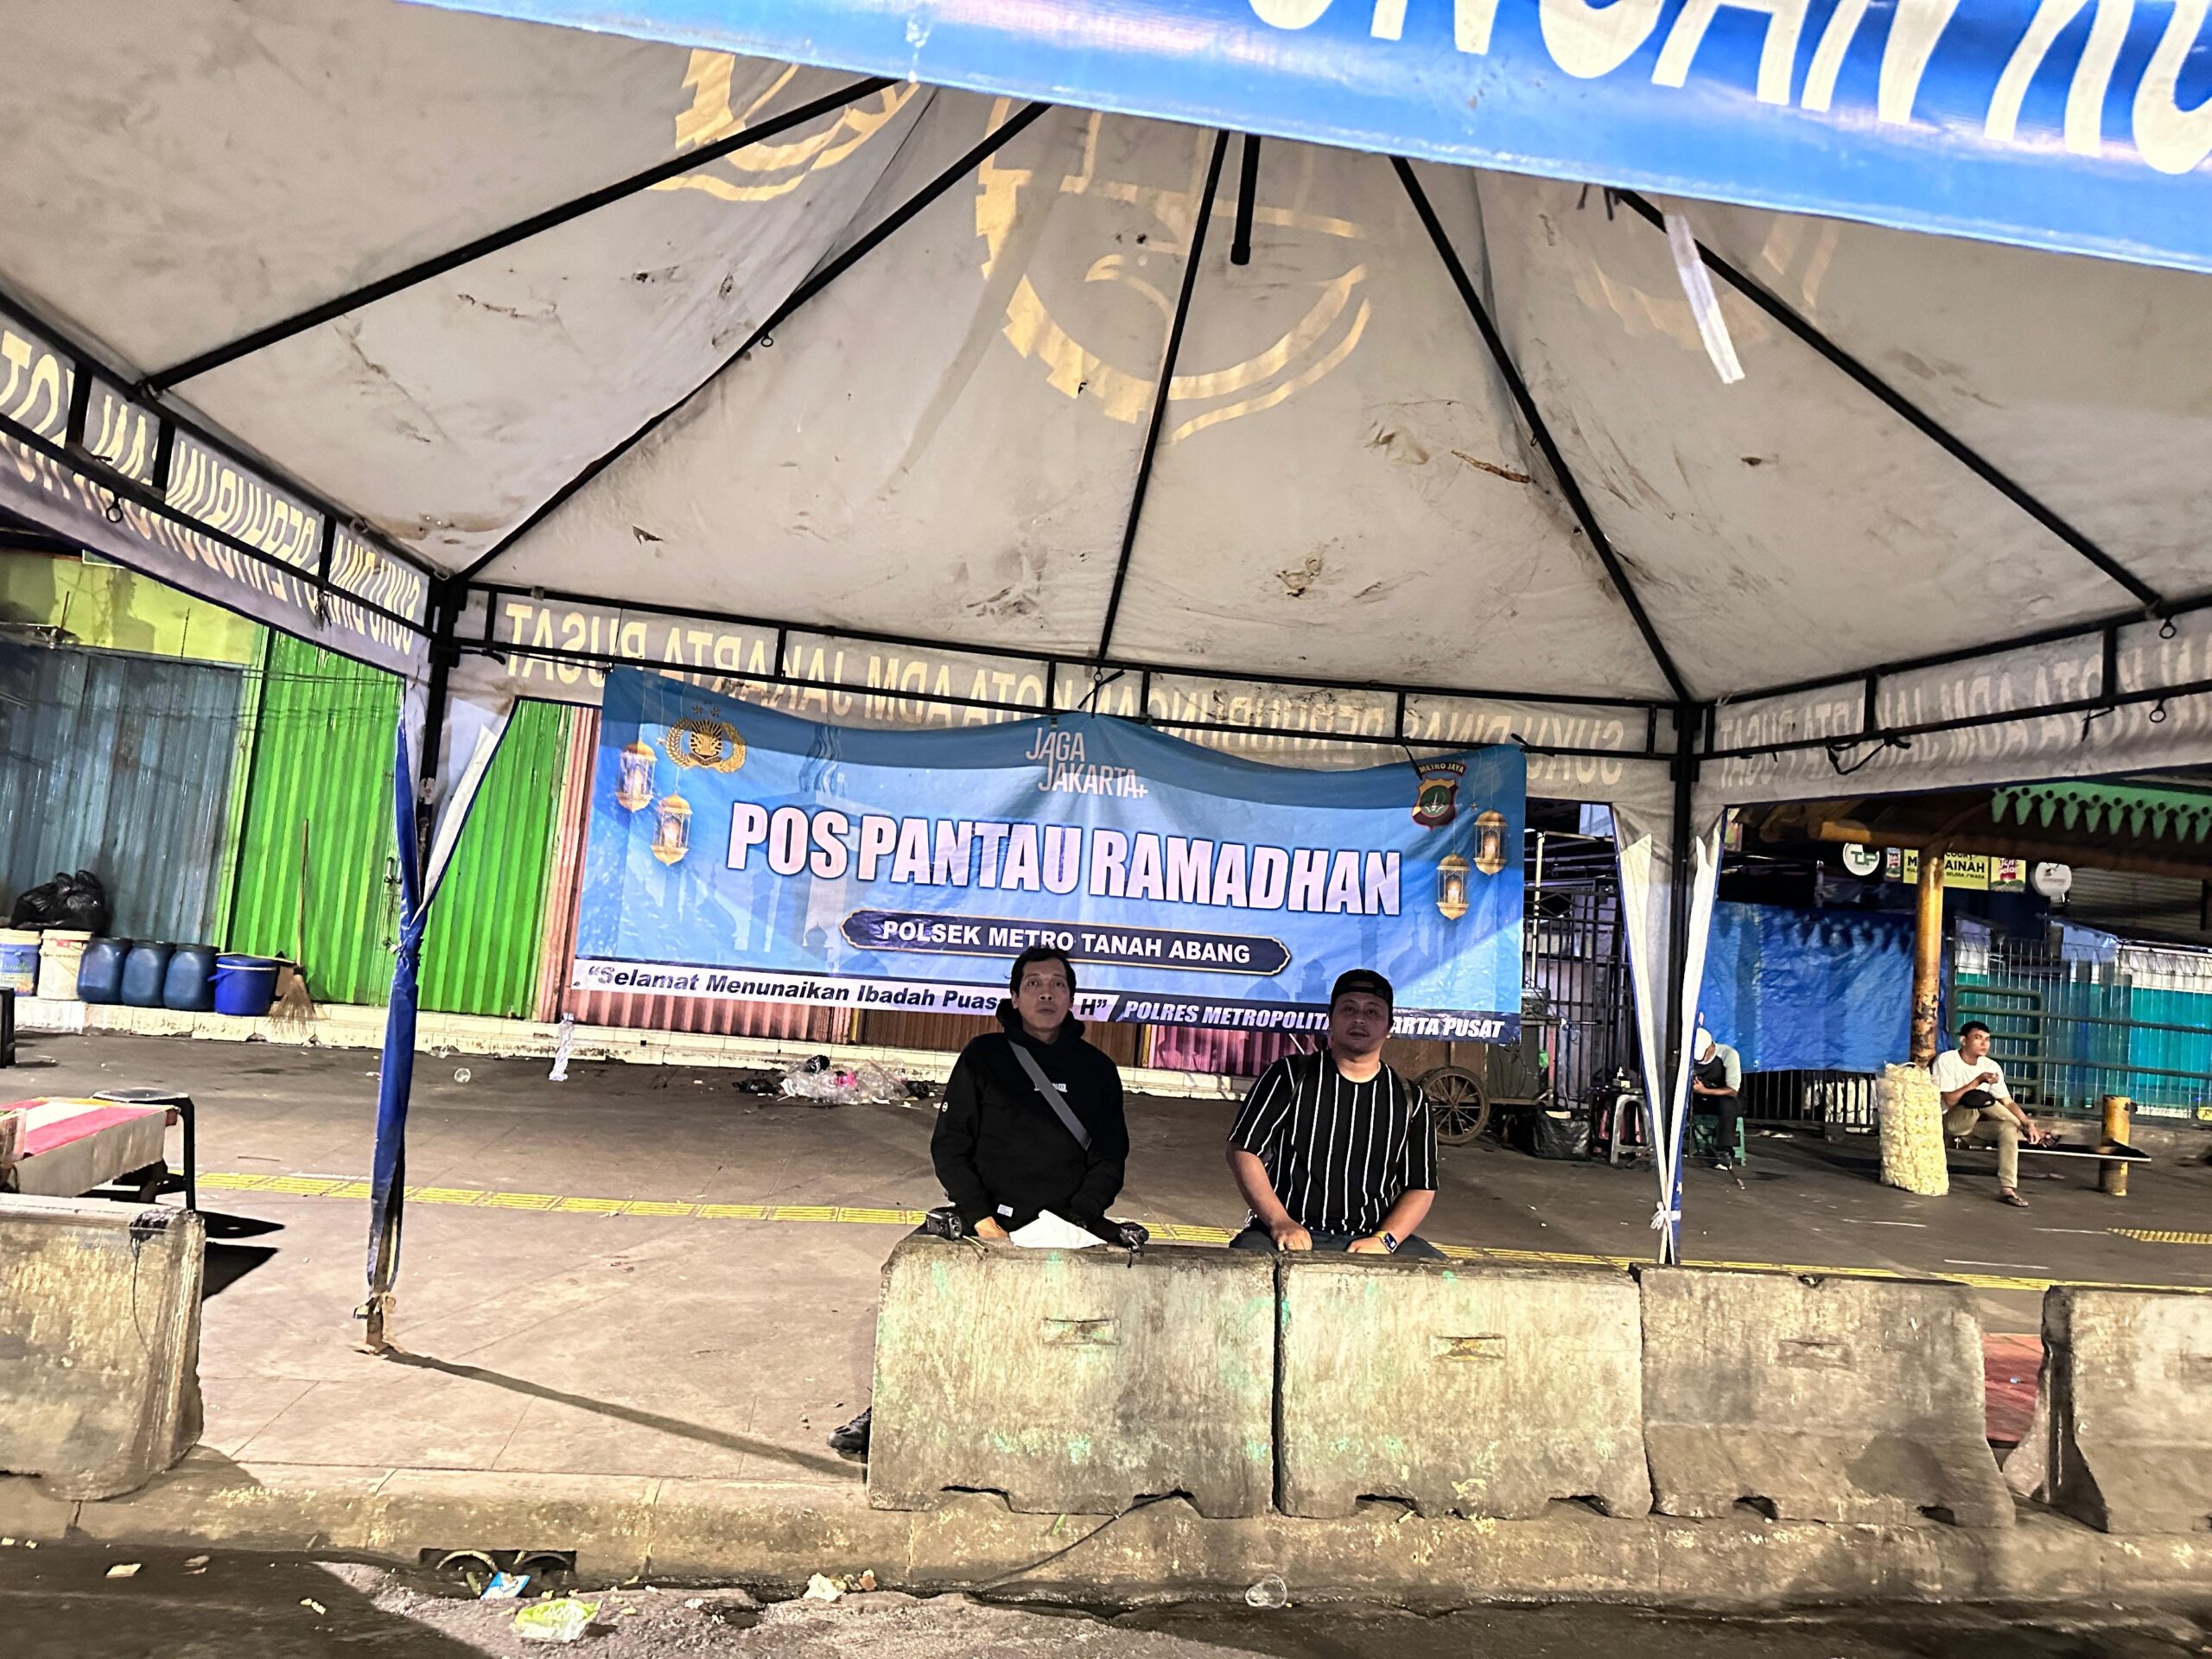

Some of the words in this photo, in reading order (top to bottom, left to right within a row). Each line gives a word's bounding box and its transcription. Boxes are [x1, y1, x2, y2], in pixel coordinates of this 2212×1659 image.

[1026, 728, 1085, 762] JAGA
[1419, 762, 1446, 773] METRO
[1447, 763, 1464, 773] JAYA
[727, 802, 849, 879] POS
[857, 815, 1083, 894] PANTAU
[1090, 829, 1401, 916] RAMADHAN
[882, 920, 982, 946] POLSEK
[988, 927, 1074, 951] METRO
[1081, 933, 1162, 957] TANAH
[1168, 939, 1250, 964] ABANG
[705, 975, 849, 1001] Menunaikan
[857, 983, 935, 1007] Ibadah
[942, 989, 1003, 1010] Puas
[1123, 1001, 1198, 1020] POLRES
[1203, 1006, 1330, 1031] METROPOLIT
[1390, 1015, 1440, 1035] ARTA
[1442, 1017, 1505, 1039] PUSAT
